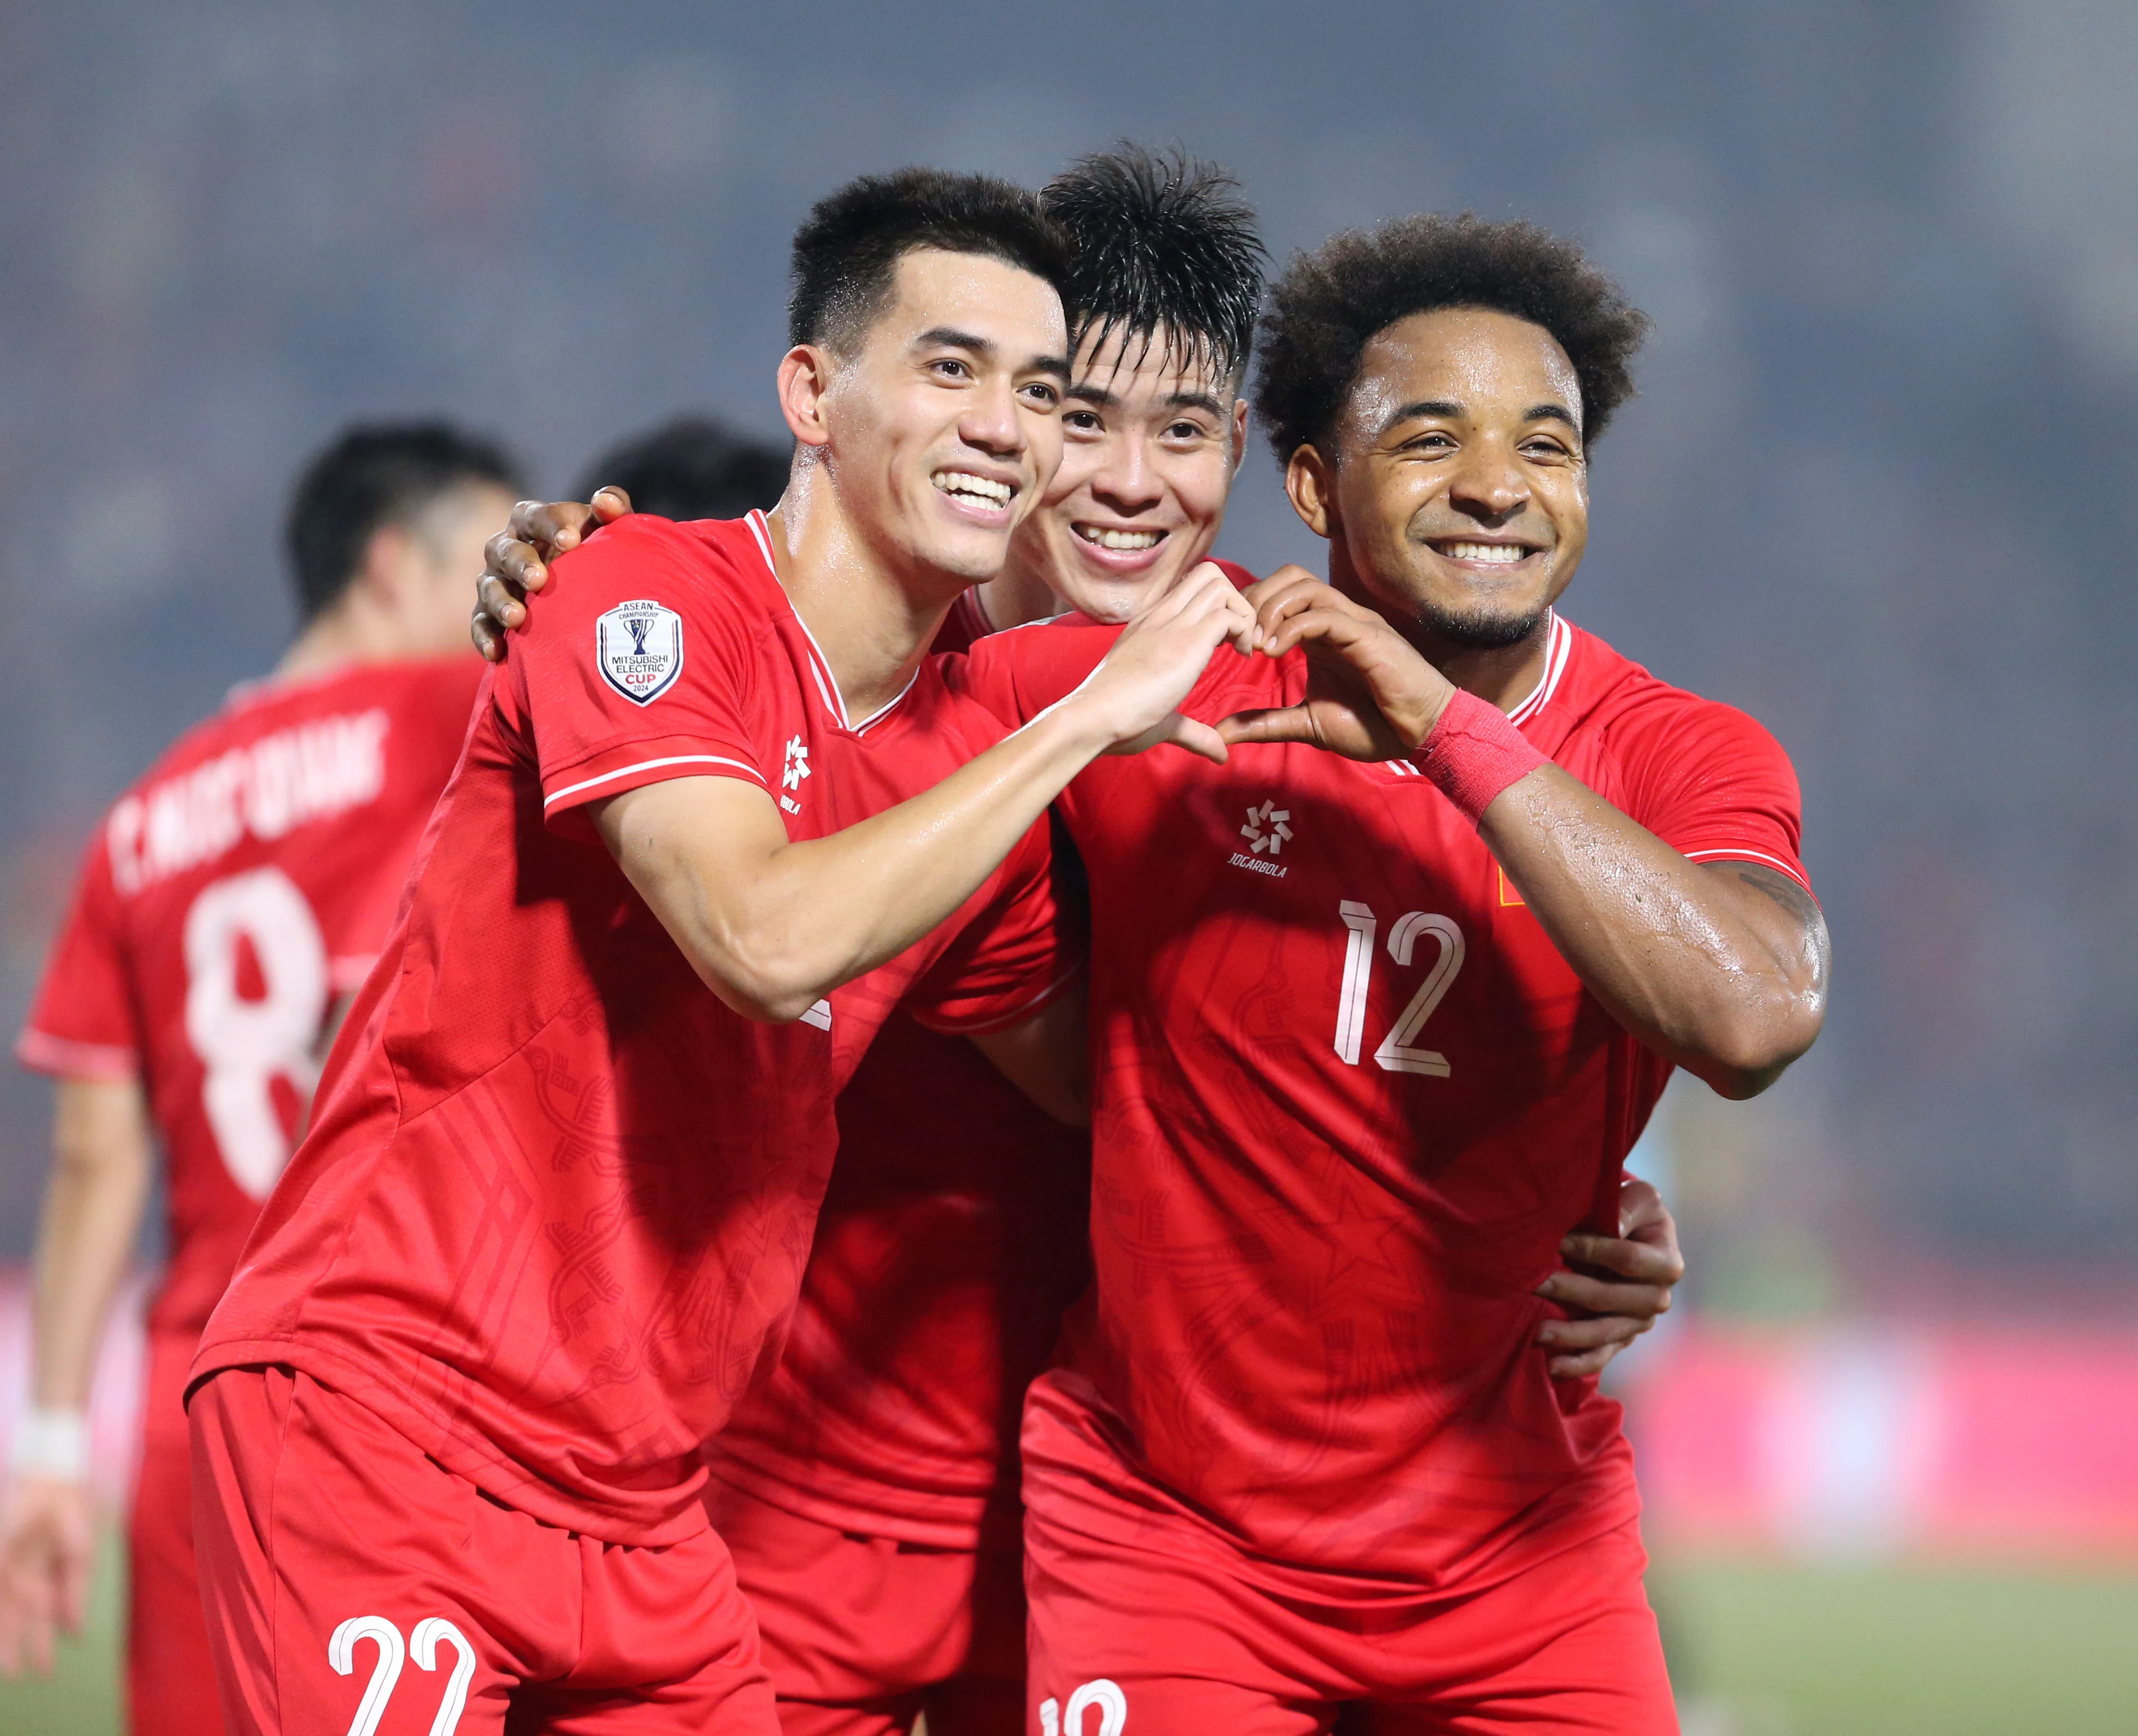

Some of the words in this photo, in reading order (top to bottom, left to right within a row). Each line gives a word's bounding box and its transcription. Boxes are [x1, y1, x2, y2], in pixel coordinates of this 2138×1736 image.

[624, 602, 653, 611] ASEAN
[619, 611, 659, 620] CHAMPIONSHIP
[612, 655, 668, 664] MITSUBISHI
[617, 664, 665, 673] ELECTRIC
[625, 674, 656, 684] CUP
[1334, 899, 1466, 1078] 12
[182, 865, 327, 1205] 8
[328, 1615, 477, 1736] 22
